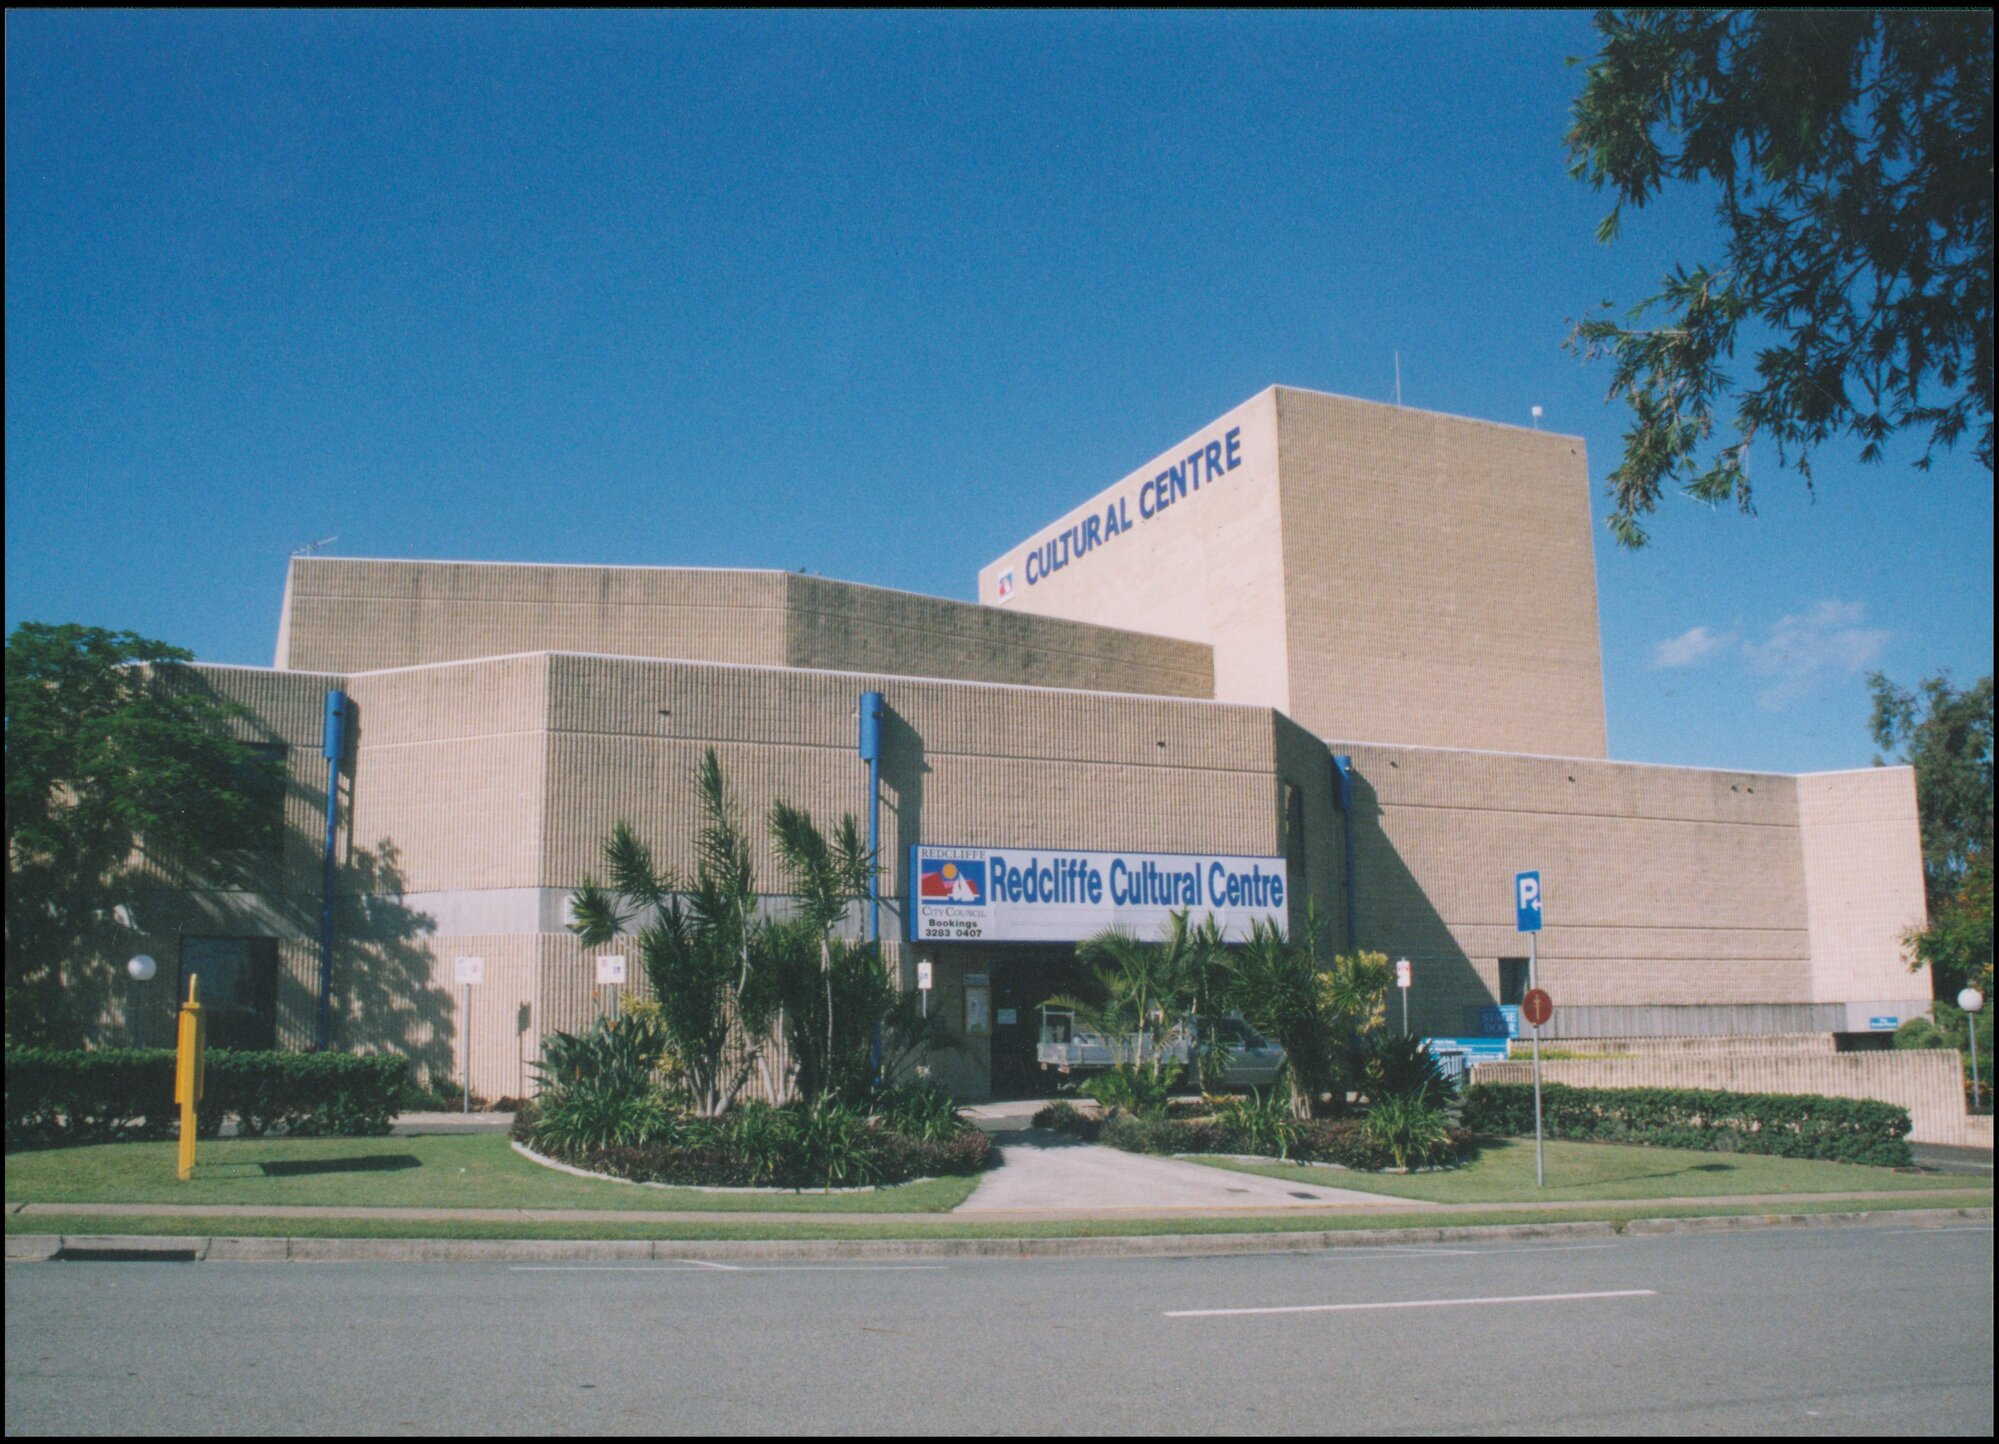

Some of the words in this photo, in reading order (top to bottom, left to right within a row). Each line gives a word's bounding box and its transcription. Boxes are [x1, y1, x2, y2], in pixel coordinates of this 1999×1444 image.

[1025, 496, 1133, 586] CULTURAL
[1139, 426, 1242, 519] CENTRE
[921, 848, 986, 860] REDCLIFFE
[989, 856, 1103, 905] Redcliffe
[1109, 858, 1203, 906] Cultural
[1208, 861, 1284, 908] Centre
[1519, 878, 1539, 910] P
[925, 929, 951, 937] 3283
[956, 929, 982, 938] 0407
[928, 919, 978, 929] Bookings
